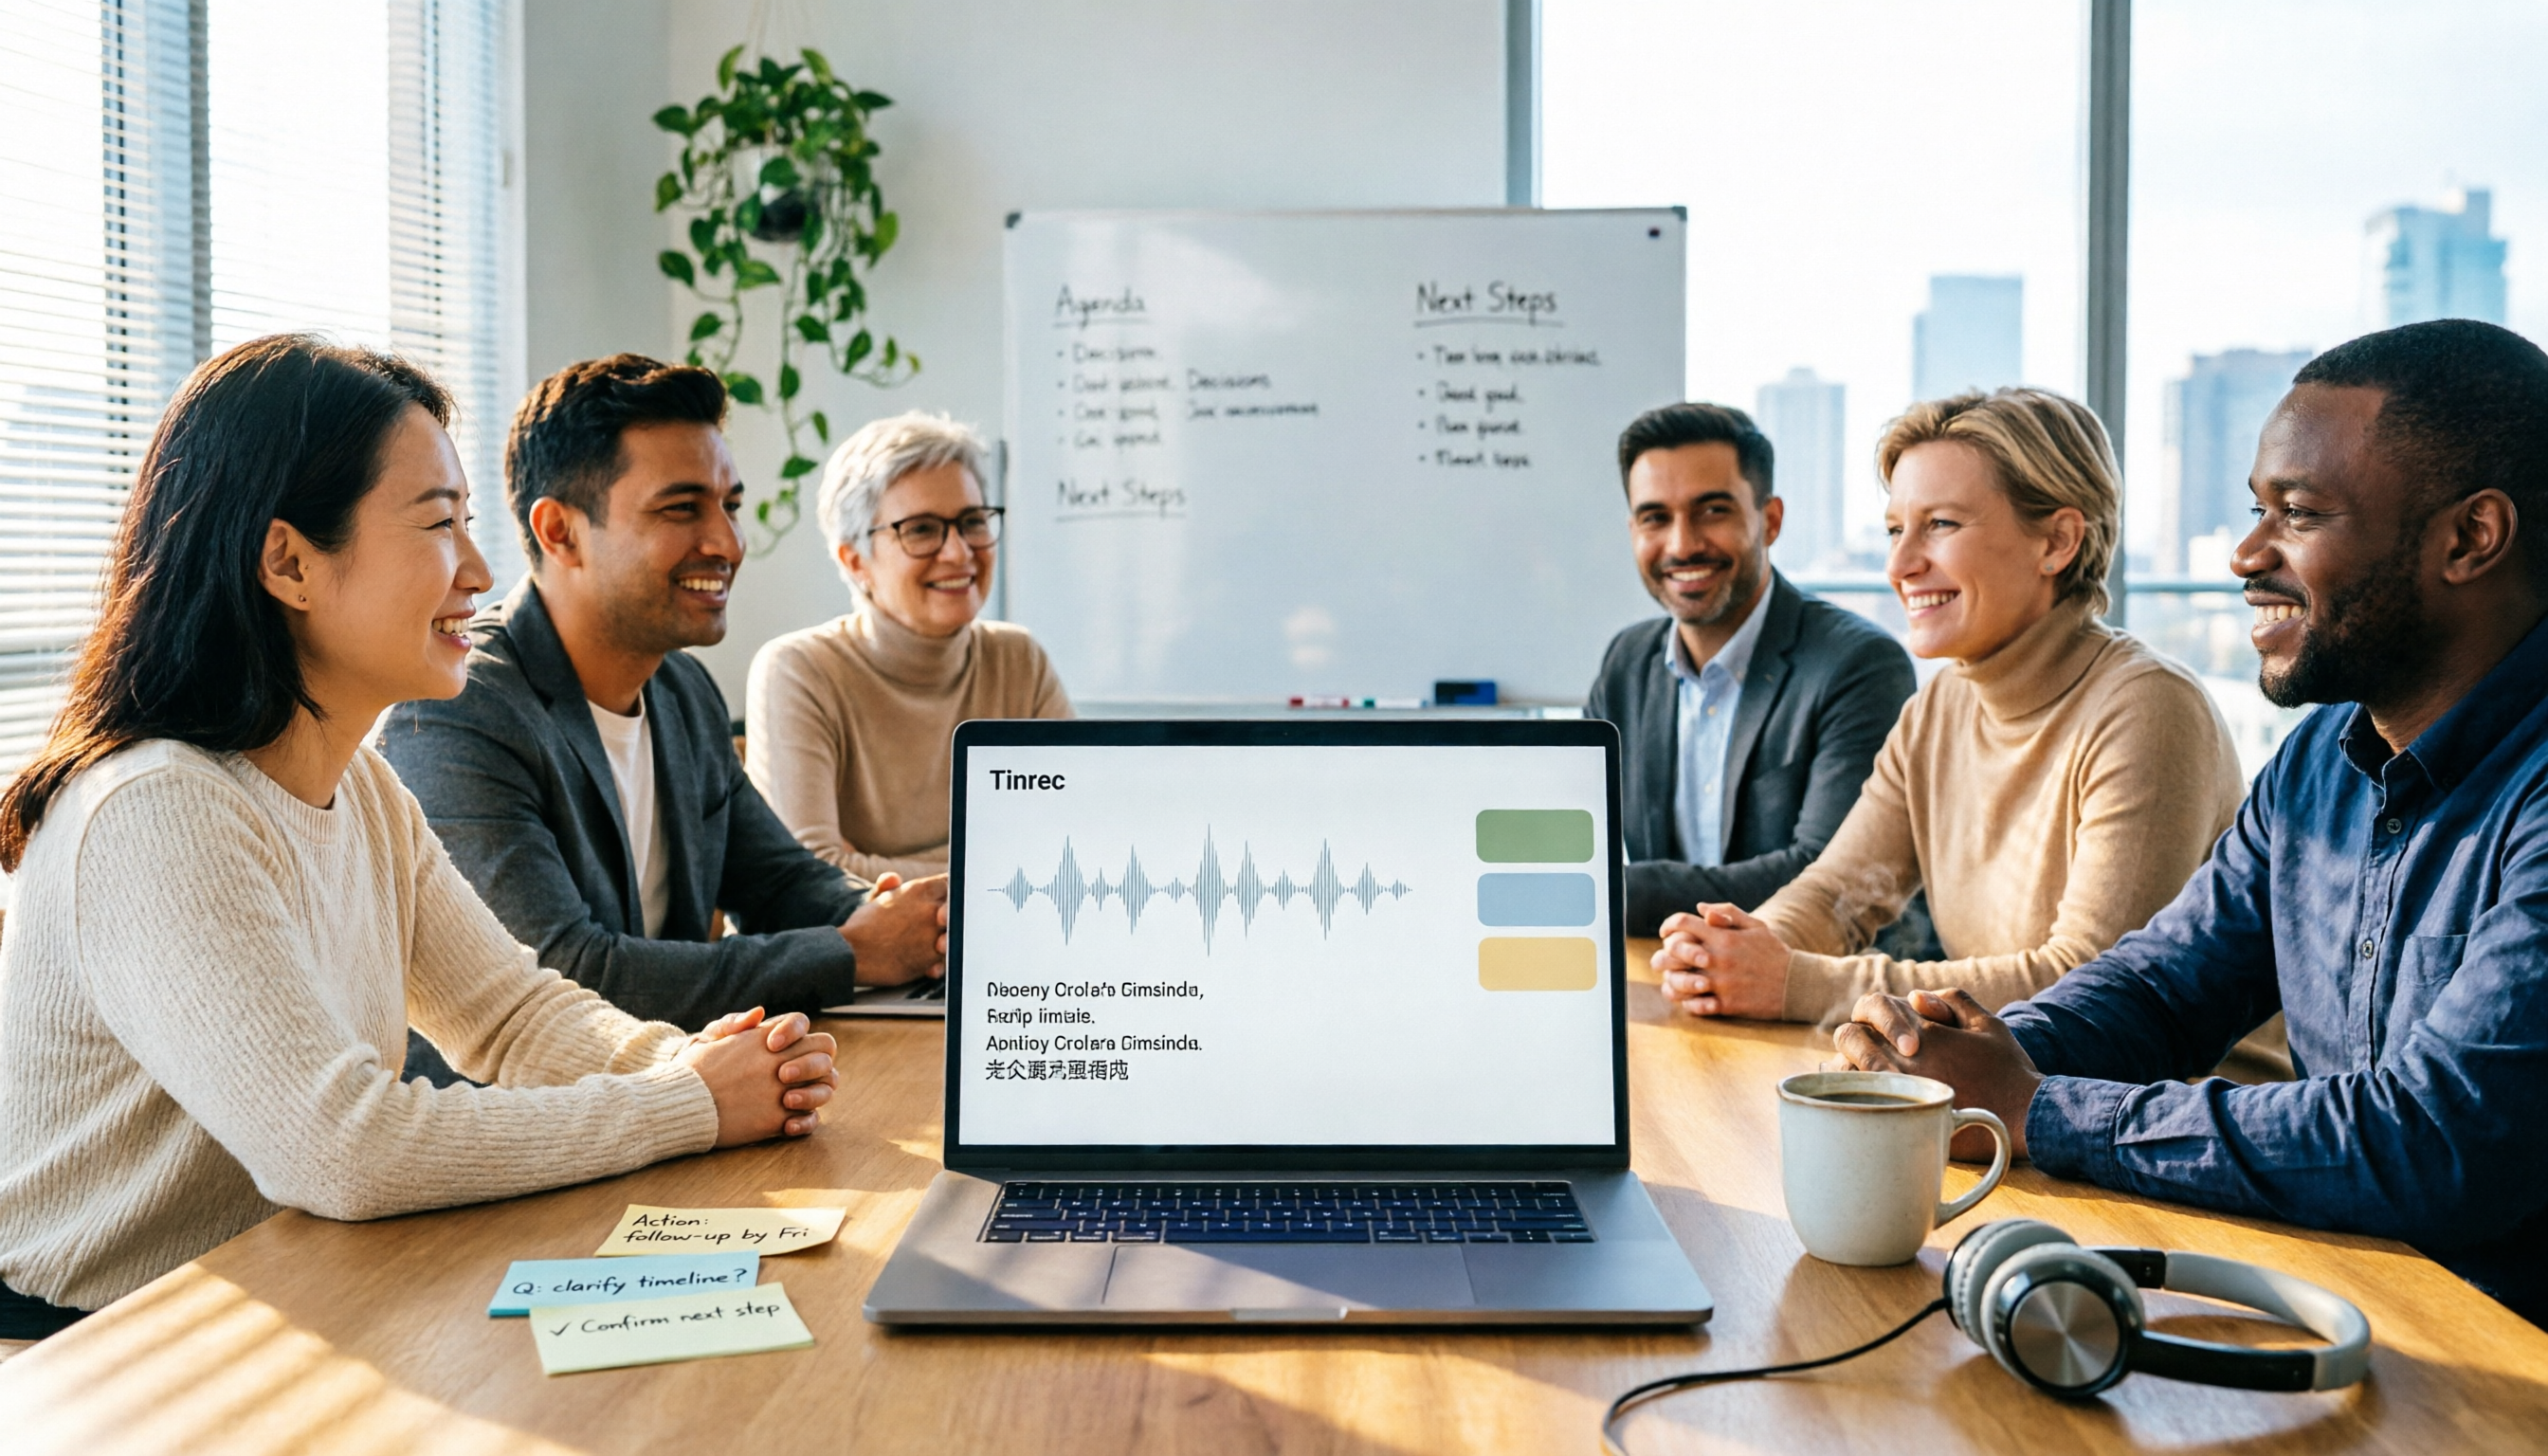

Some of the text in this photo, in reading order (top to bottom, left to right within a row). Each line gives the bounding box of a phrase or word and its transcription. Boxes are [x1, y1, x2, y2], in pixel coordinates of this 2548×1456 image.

[1055, 283, 1146, 330] Agenda
[1416, 280, 1558, 327] Next Steps
[1057, 478, 1185, 519] Next Steps
[989, 769, 1065, 791] Tinrec
[631, 1213, 709, 1228] Action:
[623, 1227, 810, 1246] follow-up by Fri
[512, 1282, 541, 1296] Q:
[552, 1276, 627, 1297] clarify
[580, 1301, 781, 1334] Confirm next step
